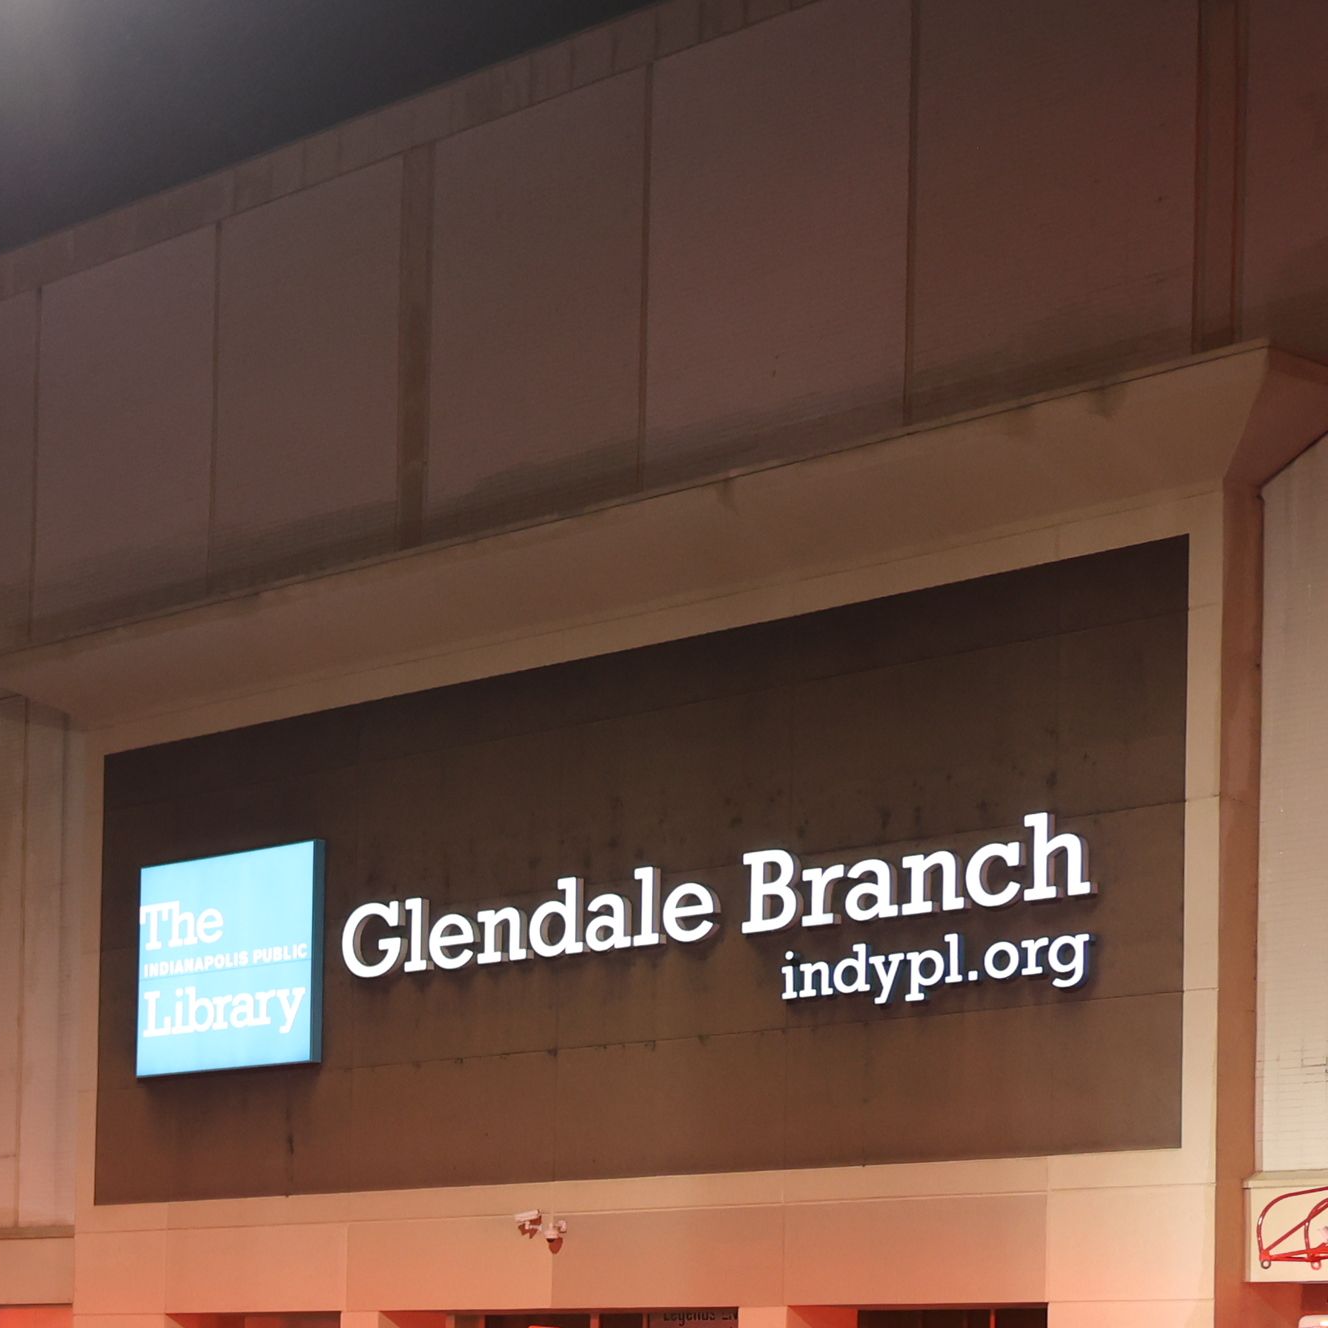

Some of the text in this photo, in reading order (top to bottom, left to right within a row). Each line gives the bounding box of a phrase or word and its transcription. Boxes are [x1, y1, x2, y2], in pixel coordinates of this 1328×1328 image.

[342, 811, 1093, 979] Glendale Branch
[139, 900, 224, 951] The
[144, 943, 308, 978] INDIANAPOLIS PUBLIC
[781, 933, 1092, 1005] indypl.org
[143, 986, 306, 1040] Library
